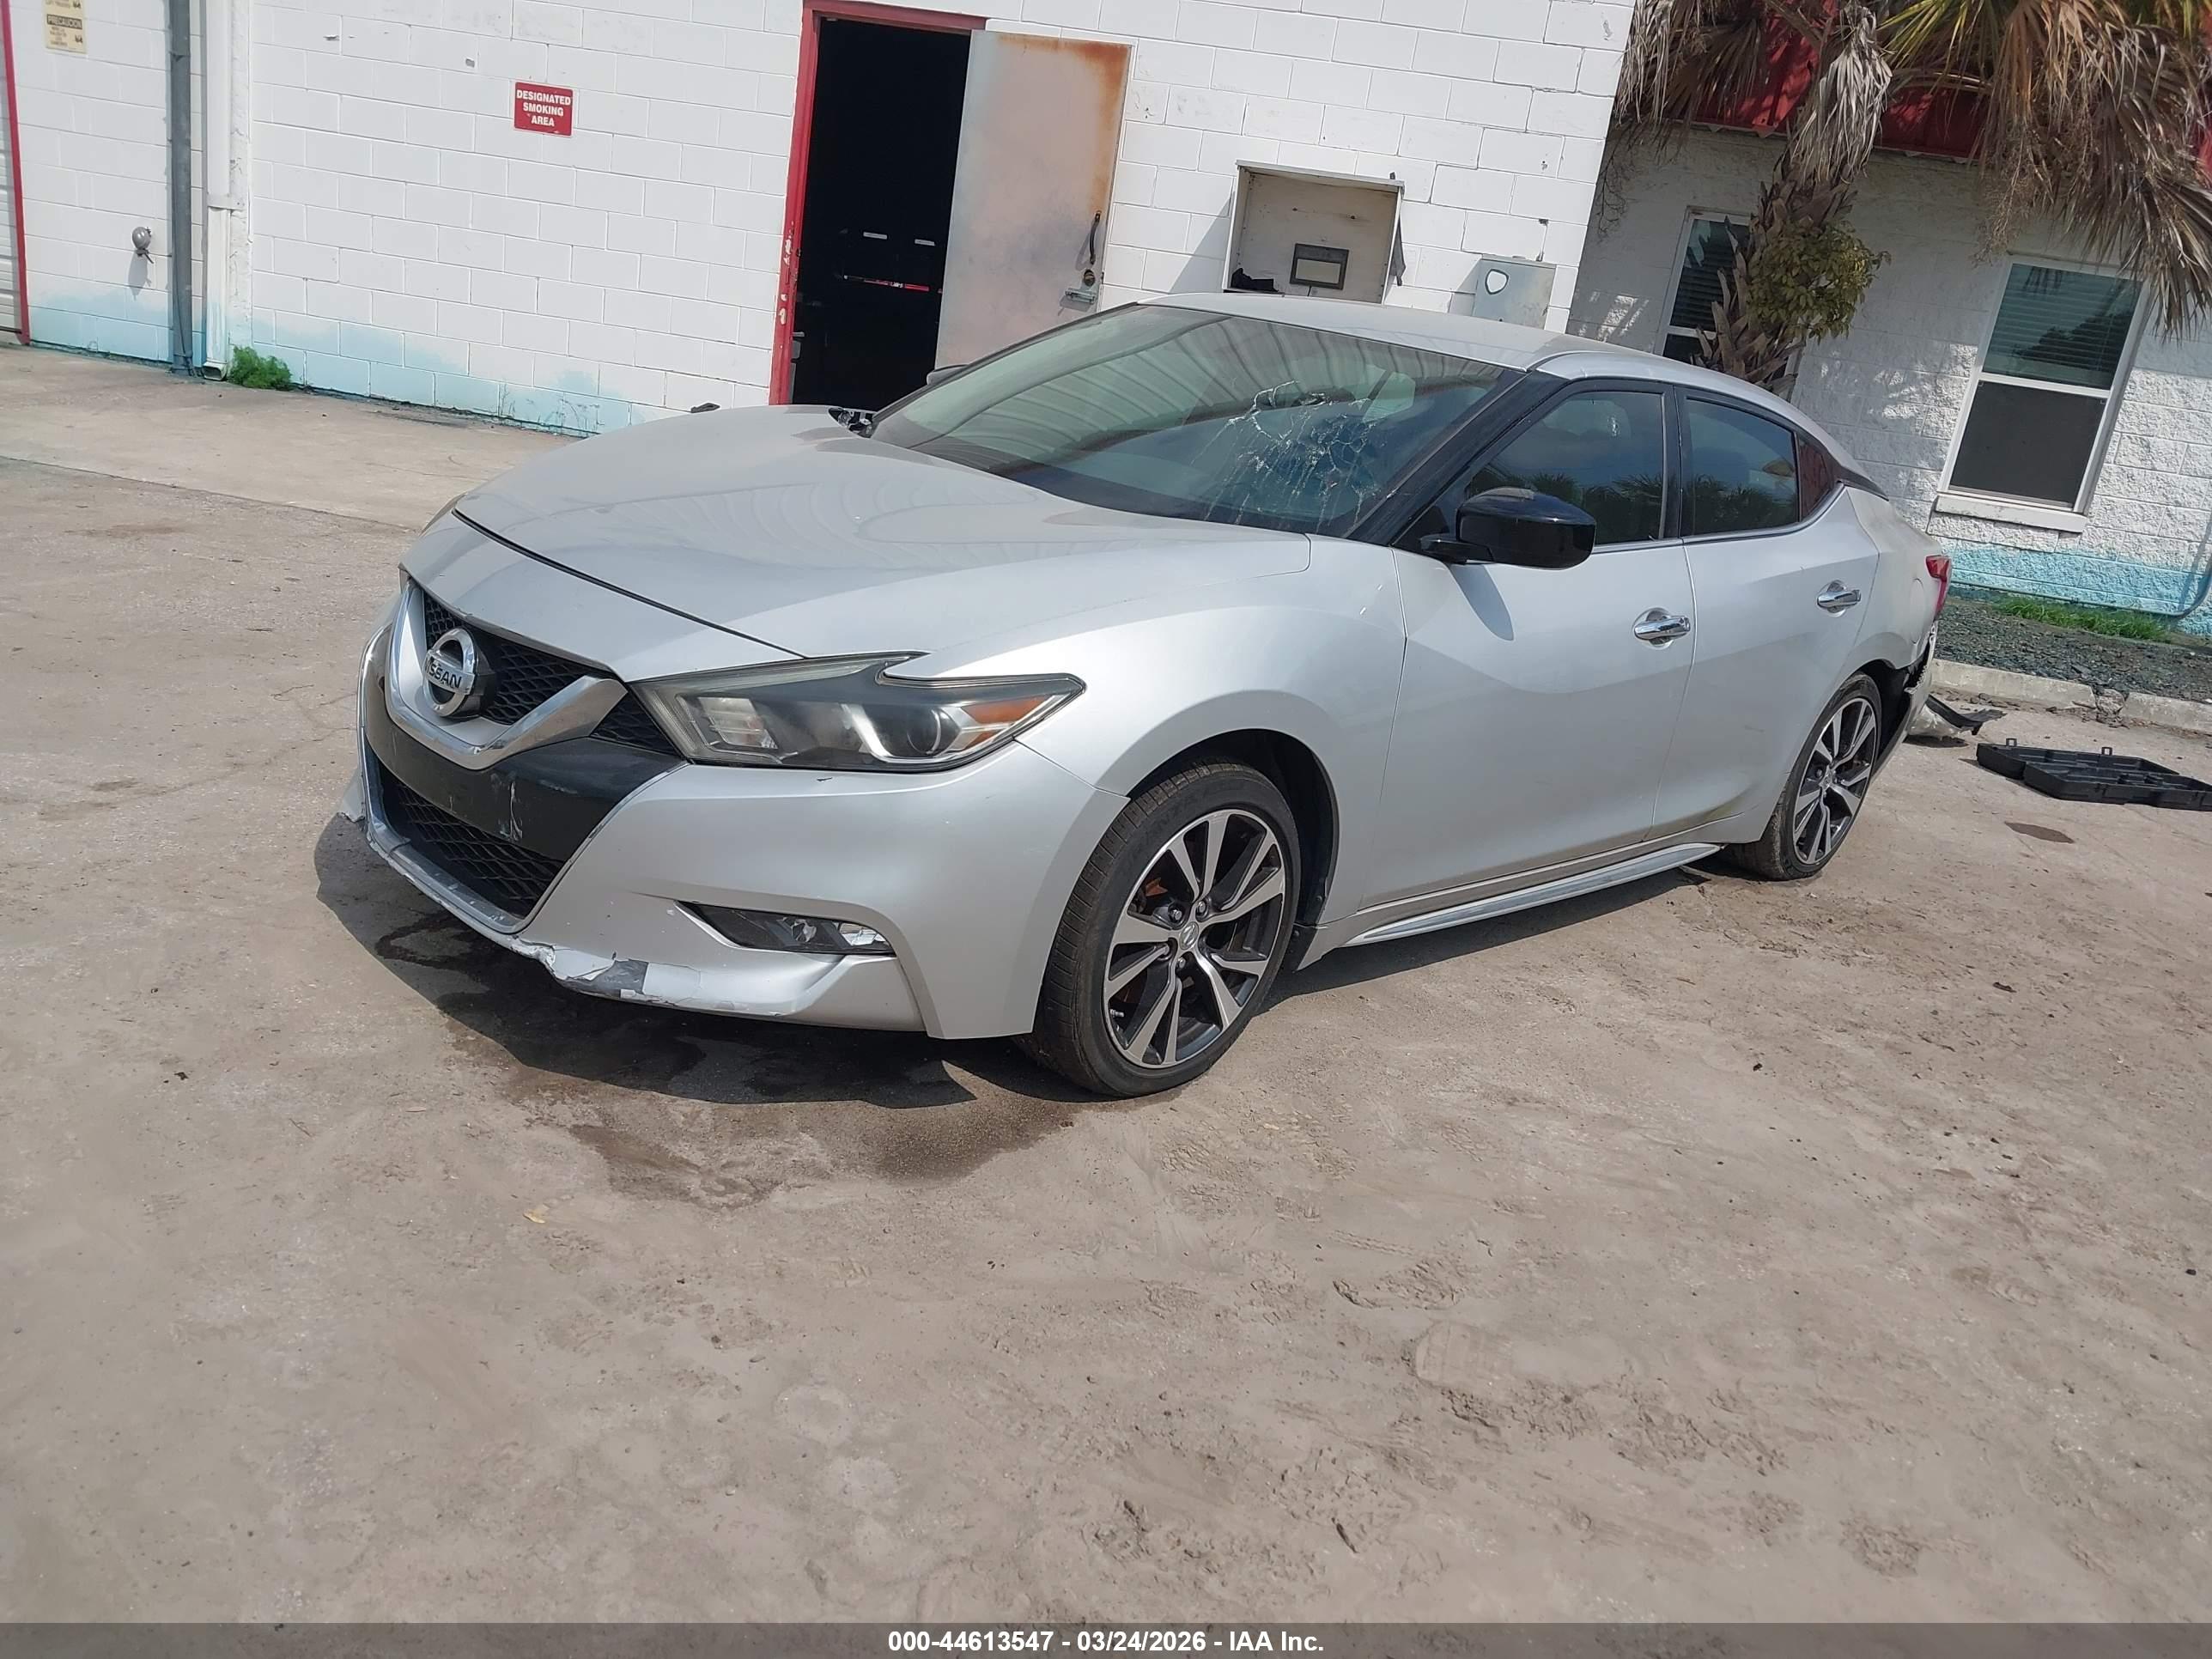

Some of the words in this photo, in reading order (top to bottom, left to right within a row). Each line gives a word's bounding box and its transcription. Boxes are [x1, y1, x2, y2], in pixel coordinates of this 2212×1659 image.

[516, 89, 571, 105] DESIGNATED
[523, 102, 564, 116] SMOKING
[531, 115, 555, 127] AREA
